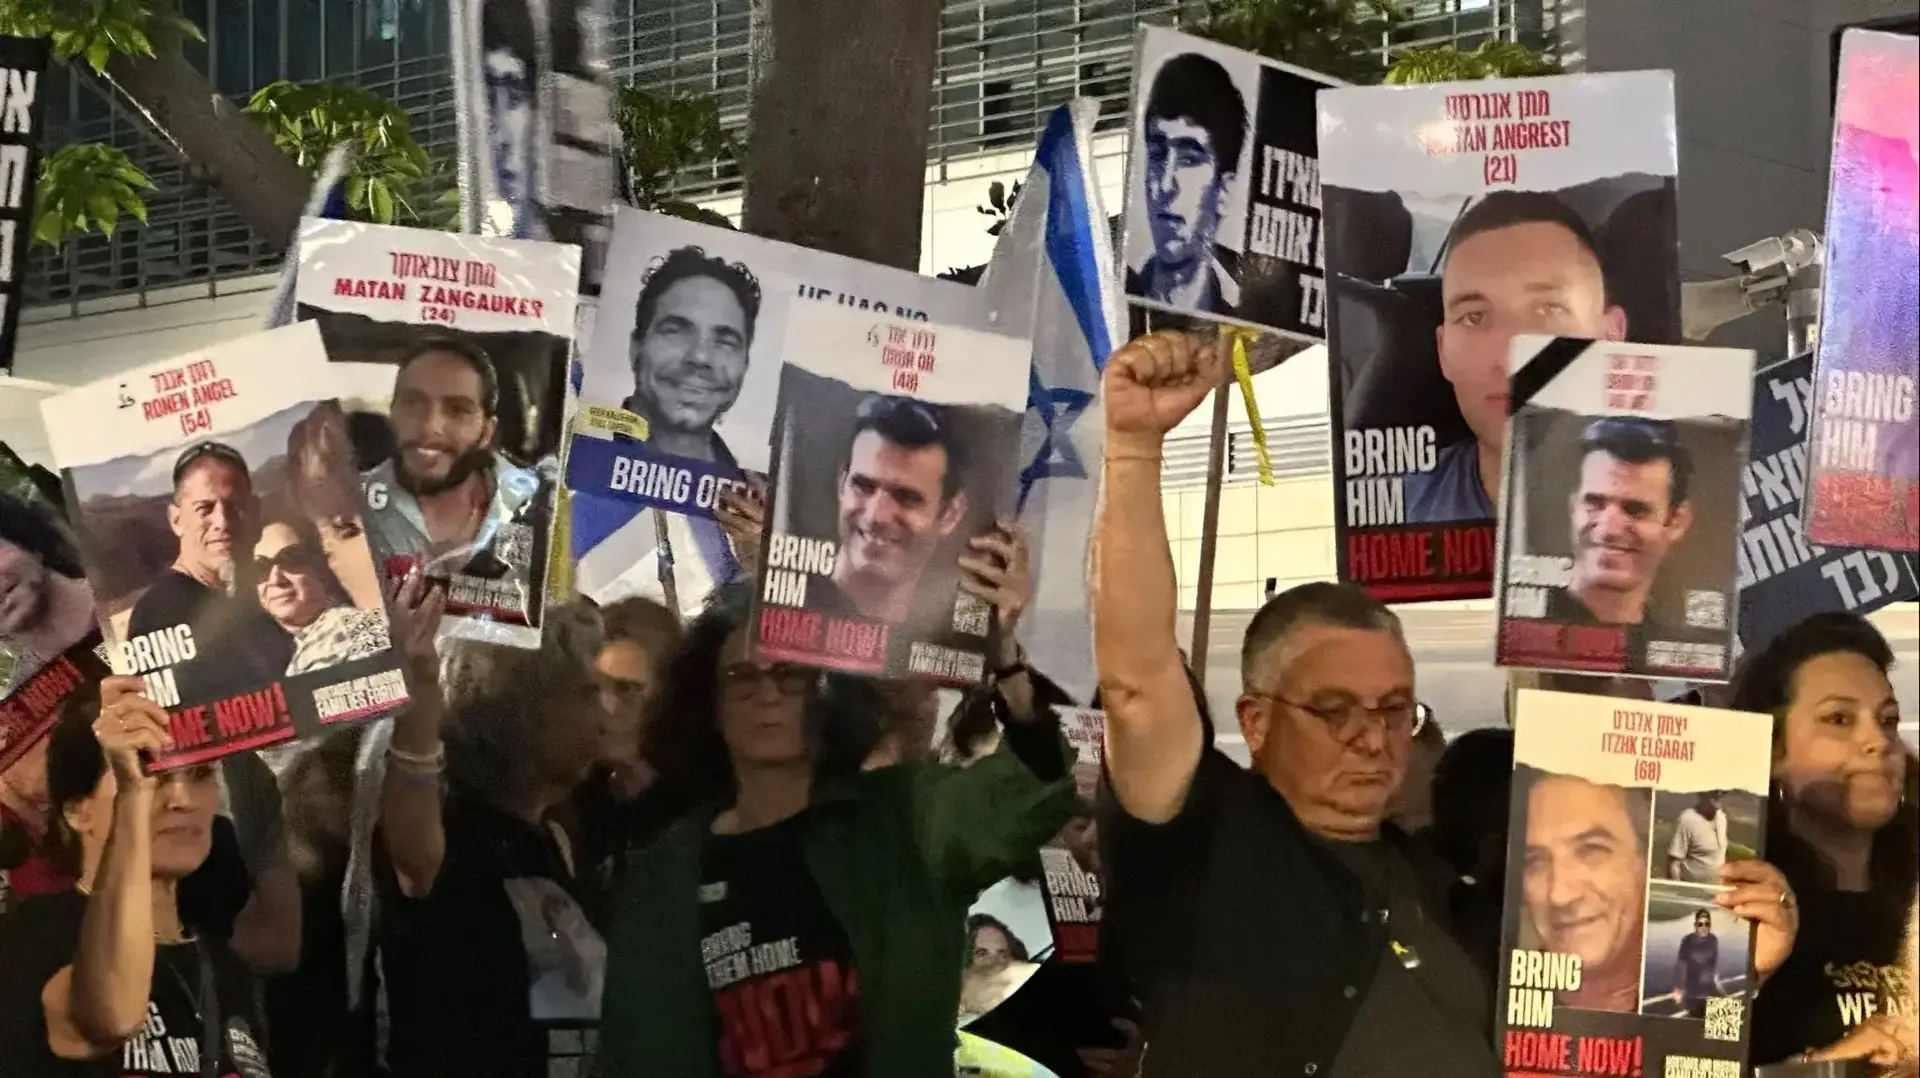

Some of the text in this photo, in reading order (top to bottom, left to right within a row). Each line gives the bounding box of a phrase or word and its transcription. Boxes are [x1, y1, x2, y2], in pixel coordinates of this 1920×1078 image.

[1492, 121, 1571, 151] ANGREST
[1483, 154, 1517, 186] (21)
[334, 278, 543, 319] MATAN ZANGAUKER
[421, 306, 456, 324] (24)
[142, 391, 190, 421] RONEN
[192, 378, 238, 407] ANGEL
[1826, 369, 1914, 423] BRING
[180, 408, 212, 436] (54)
[1344, 424, 1437, 477] BRING
[1822, 417, 1877, 473] HIM
[610, 455, 692, 504] BRING
[1346, 476, 1405, 527] HIM
[768, 532, 836, 576] BRING
[1348, 531, 1434, 580] HOME
[763, 567, 808, 608] HIM
[123, 623, 197, 676] BRING
[760, 607, 823, 650] HOME
[143, 667, 181, 708] IM
[214, 681, 291, 738] NOW!
[1601, 732, 1696, 762] ITZHK ELGARAT
[1634, 757, 1661, 784] (68)
[1048, 870, 1100, 899] BRING
[1051, 895, 1089, 923] HIM
[1510, 948, 1582, 992] BRING
[1507, 987, 1554, 1029] HIM
[1503, 1030, 1643, 1077] HOME NOW!
